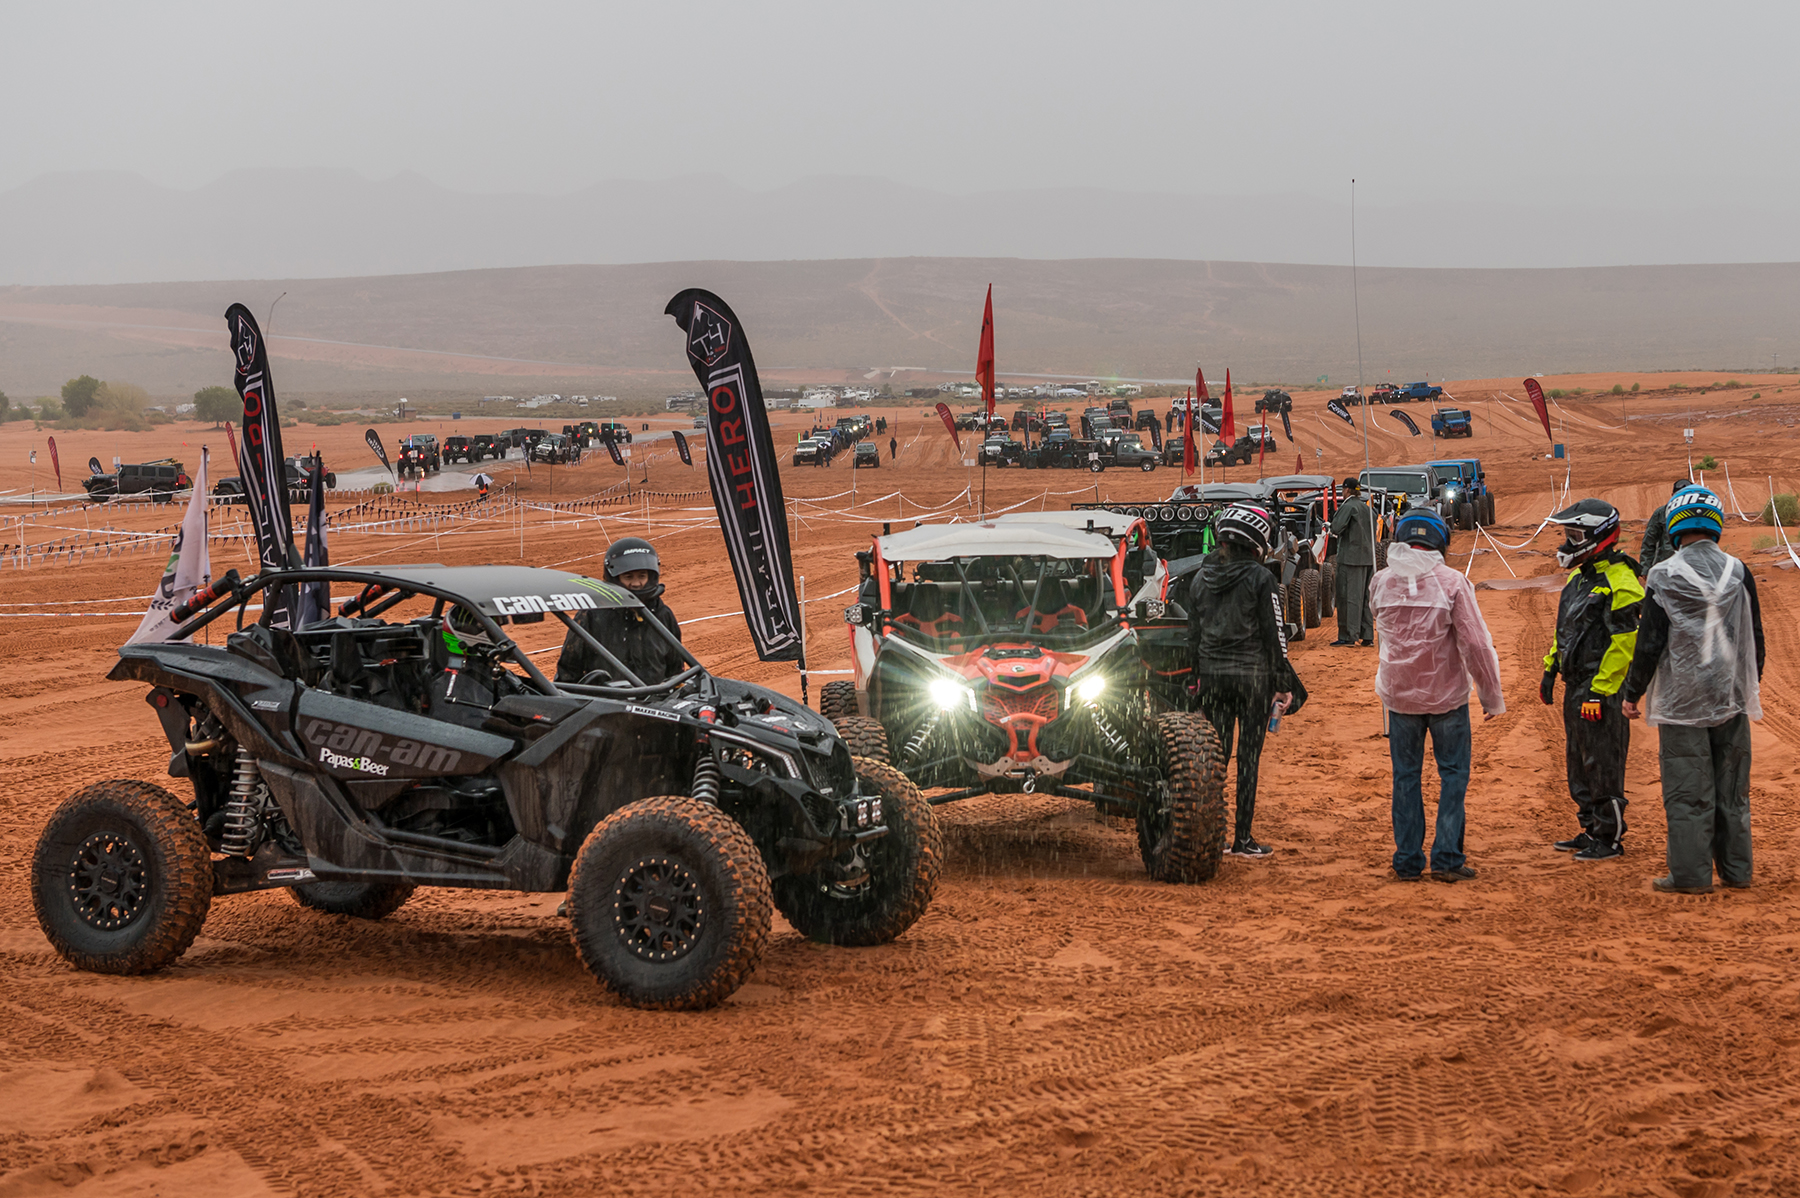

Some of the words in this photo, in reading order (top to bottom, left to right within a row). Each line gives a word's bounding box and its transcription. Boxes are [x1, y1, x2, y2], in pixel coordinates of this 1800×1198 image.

[711, 385, 756, 510] HERO
[492, 592, 598, 615] can-am
[304, 719, 462, 772] can-am
